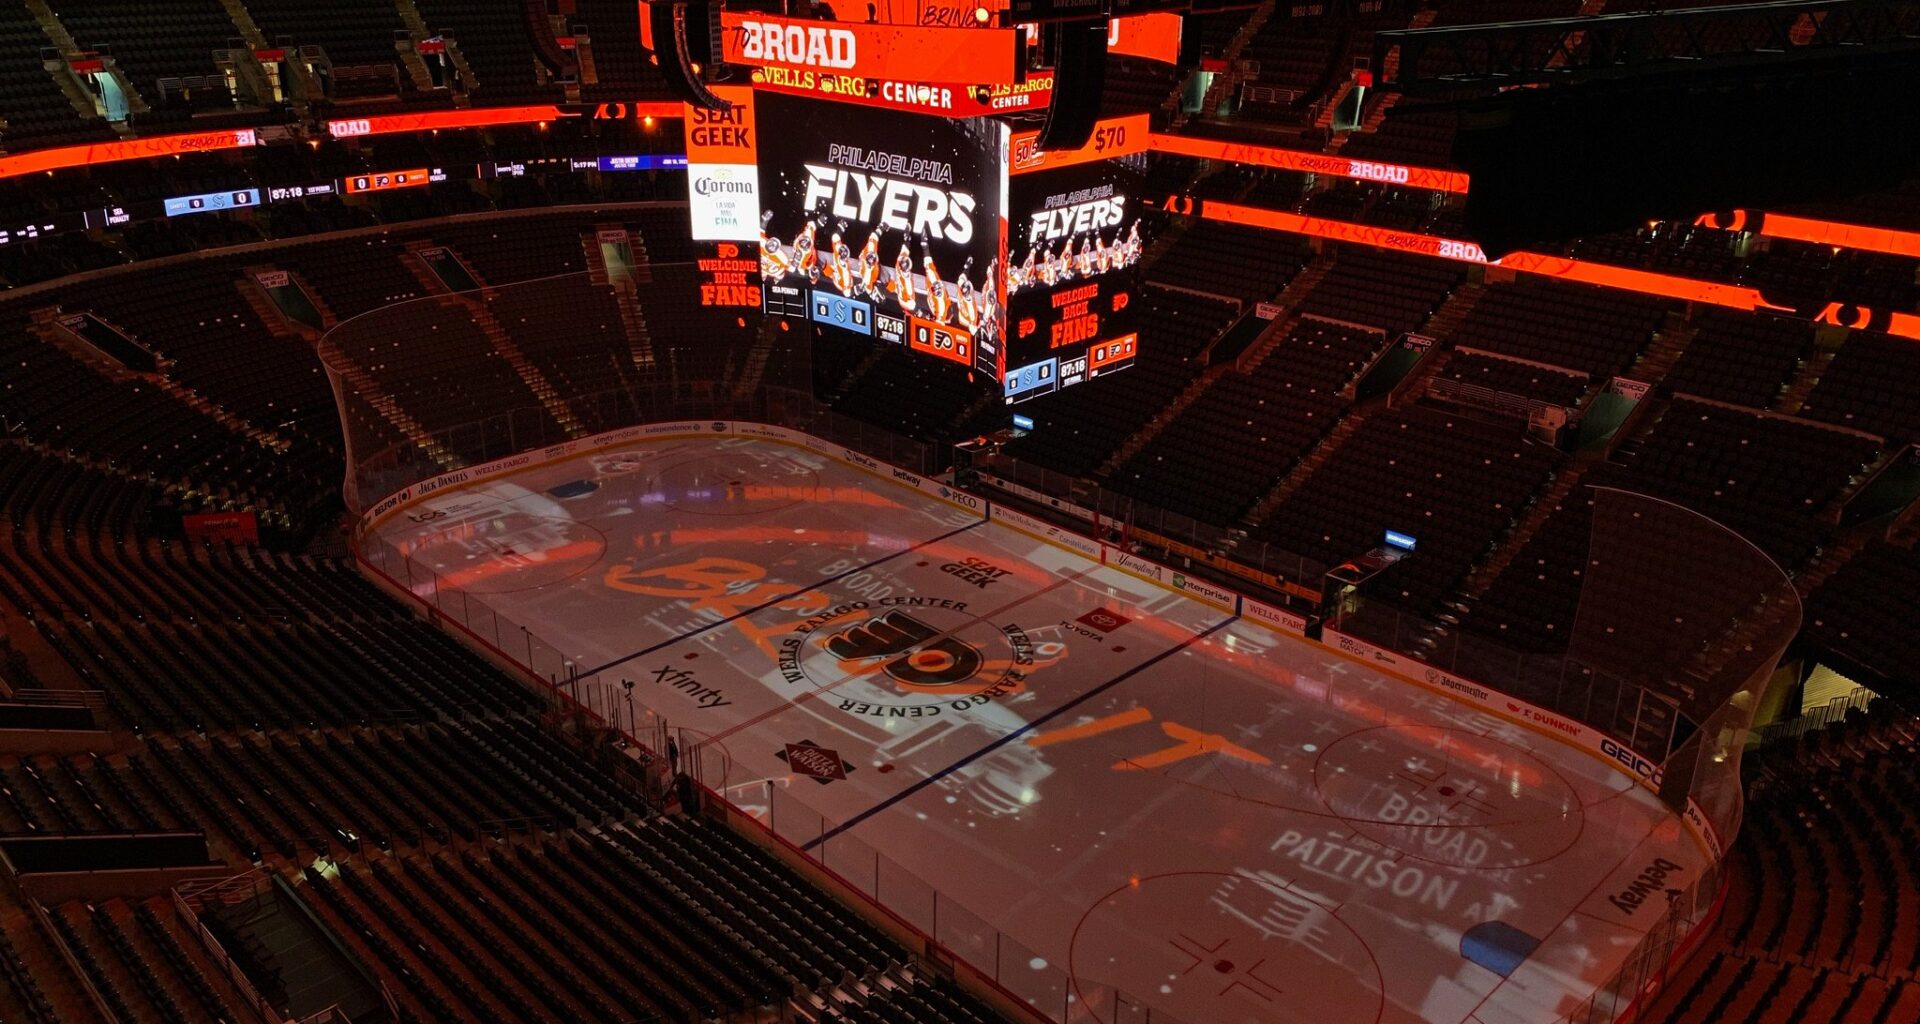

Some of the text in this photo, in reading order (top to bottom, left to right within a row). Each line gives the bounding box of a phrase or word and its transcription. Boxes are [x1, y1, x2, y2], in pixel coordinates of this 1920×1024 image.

[742, 21, 857, 70] BROAD
[820, 74, 876, 99] ARG
[964, 80, 1011, 101] WLLS
[991, 94, 1029, 109] CENTER
[693, 104, 746, 125] SEAT
[691, 126, 750, 149] GEEK
[1015, 142, 1038, 164] 50/5
[1094, 126, 1126, 153] $70
[828, 143, 954, 185] PHILADELPHIA
[1350, 160, 1409, 183] BROAD
[357, 178, 366, 190] 0
[398, 175, 404, 183] 0
[695, 177, 753, 197] Corona
[193, 200, 200, 208] 0
[238, 193, 246, 205] 0
[272, 187, 303, 200] 87:18
[803, 164, 977, 245] FLYERS
[1044, 184, 1114, 209] PHILADELPHIA
[1028, 196, 1126, 244] FLYERS
[698, 260, 757, 272] WELCOME
[714, 272, 747, 284] BACK
[700, 285, 761, 307] FANS
[1052, 283, 1098, 309] WELCOME
[820, 305, 827, 316] 0
[855, 310, 862, 324] 0
[1063, 301, 1088, 320] BACK
[877, 316, 904, 336] 87:18
[919, 328, 926, 342] 0
[1051, 313, 1098, 349] FANS
[959, 344, 966, 355] 0
[1097, 344, 1131, 361] 0 0
[1041, 366, 1048, 378] 0
[1061, 359, 1086, 378] 87:18
[1010, 379, 1016, 388] 0
[475, 457, 530, 476] WELLS FARGO
[418, 478, 437, 494] JACK
[893, 468, 921, 488] betway
[375, 497, 397, 517] BELFOR
[952, 490, 977, 509] PECO
[940, 563, 998, 589] GEEK
[959, 556, 1014, 578] SEAT
[1115, 553, 1156, 577] Yuengling
[818, 558, 894, 603] BROAD
[1248, 604, 1306, 633] WELLS FARG
[778, 596, 969, 685] WELLS FARGO CENTER
[1060, 620, 1104, 643] TOYOTA
[839, 623, 1035, 718] WELLS FARGO CENTER
[650, 664, 733, 709] xfinity
[1439, 675, 1489, 702] Jägermeister
[790, 748, 835, 778] WATSON
[802, 747, 829, 766] DIETZ
[1600, 738, 1664, 786] GEICO
[1377, 791, 1488, 866] BROAD
[1269, 829, 1459, 911] PATTISON
[1607, 857, 1684, 916] betway
